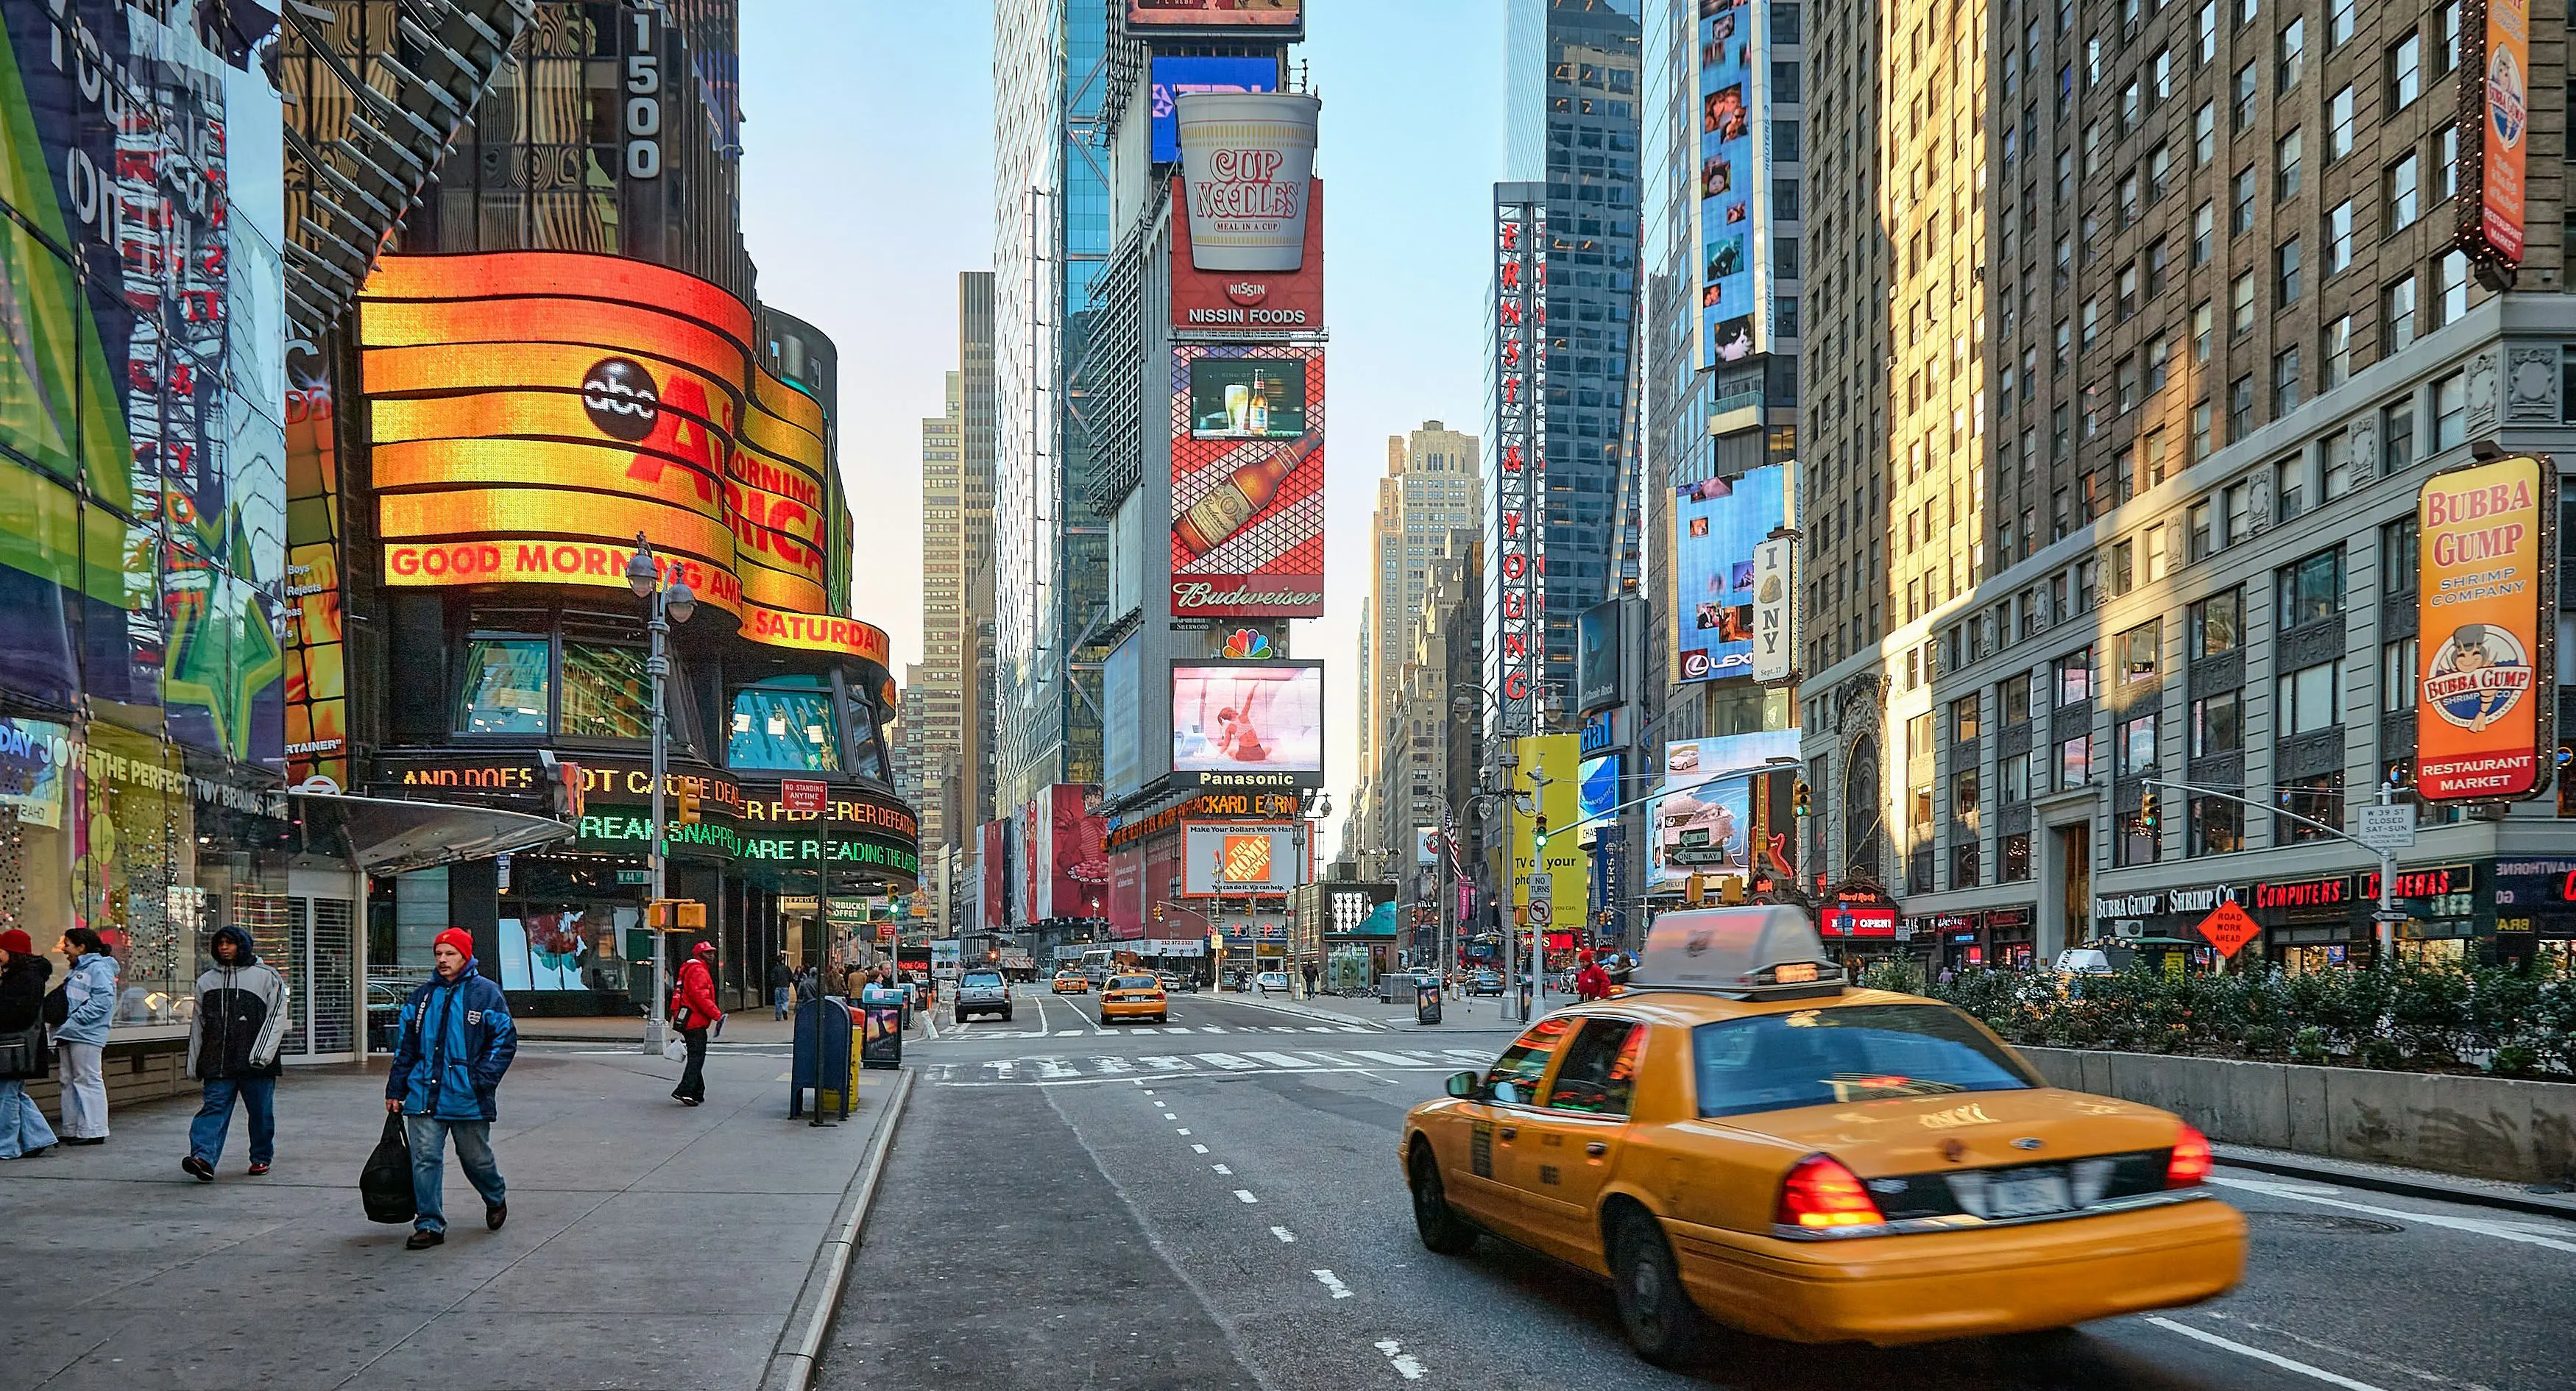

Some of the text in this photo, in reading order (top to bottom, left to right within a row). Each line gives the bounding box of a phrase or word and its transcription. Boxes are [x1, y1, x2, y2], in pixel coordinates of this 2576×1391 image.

[627, 14, 660, 178] 1500
[1210, 149, 1283, 183] CUP
[1194, 182, 1298, 219] NOODLES
[1230, 282, 1265, 297] NISSIN
[1189, 308, 1306, 323] NISSIN FOODS
[1501, 224, 1521, 401] ERNST
[584, 375, 656, 420] abc
[2426, 478, 2534, 529] BUBBA
[2432, 522, 2525, 568] GUMP
[392, 546, 502, 576] GOOD
[288, 564, 310, 575] Boys
[2440, 567, 2516, 590] SHRIMP
[287, 584, 322, 596] Rejects
[1172, 581, 1322, 608] Budweiser
[2431, 579, 2527, 606] COMPANY
[286, 606, 302, 617] eas
[1504, 512, 1526, 699] YOUNG
[1776, 666, 1782, 674] 17
[2427, 669, 2529, 699] BUBBA GUMP
[2442, 693, 2480, 706] SHRIMP
[2422, 756, 2531, 776] RESTAURANT
[96, 748, 127, 782] THE
[131, 760, 192, 796] PERFECT
[195, 776, 219, 804] TOY
[1200, 773, 1294, 785] Panasonic
[2440, 774, 2512, 791] MARKET
[790, 792, 819, 800] ANYTIME
[796, 785, 824, 793] STANDING
[2368, 817, 2404, 825] CLOSED
[1682, 834, 1691, 842] ONE
[745, 839, 795, 860] ARE
[802, 839, 884, 865] READING
[885, 847, 901, 867] THE
[1228, 839, 1250, 858] THE
[1678, 852, 1694, 860] ONE
[1225, 835, 1270, 881] HOME
[1515, 857, 1527, 868] TV
[1546, 857, 1577, 870] your
[1242, 851, 1270, 882] DEPOT
[618, 872, 624, 882] W
[626, 872, 634, 882] 44
[1535, 877, 1546, 885] NO
[1531, 885, 1550, 893] TURNS
[2257, 880, 2341, 909] COMPUTERS
[1839, 892, 1876, 903] Hard Rock
[2096, 897, 2127, 919] BUBBA
[2127, 894, 2156, 917] GUMP
[2169, 888, 2214, 914] SHRIMP
[832, 910, 858, 918] OFFEE
[2218, 912, 2243, 921] ROAD
[1859, 919, 1892, 928] OPEN!
[2217, 923, 2242, 932] WORK
[2215, 933, 2241, 943] AHEAD
